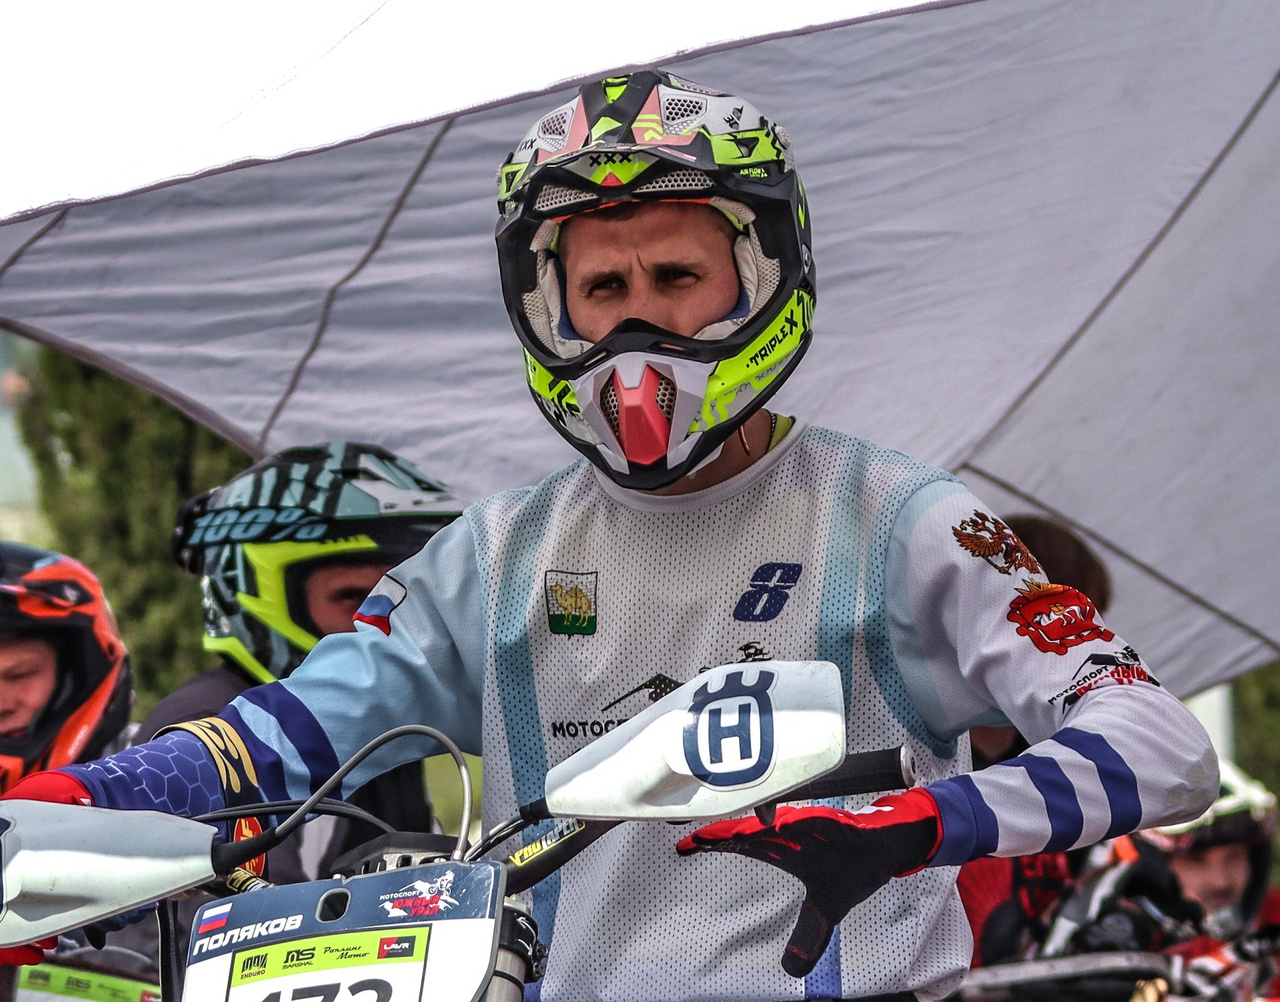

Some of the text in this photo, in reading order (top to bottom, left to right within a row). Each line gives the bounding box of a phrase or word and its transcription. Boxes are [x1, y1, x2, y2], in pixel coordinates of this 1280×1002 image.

[187, 507, 329, 547] 100%
[732, 561, 803, 623] 8
[1047, 665, 1109, 706] МОТОСПОРТ
[551, 717, 630, 739] МОТОС
[379, 890, 420, 901] МОТОСПОРТ
[192, 914, 304, 957] ПОЛЯКОВ
[383, 942, 410, 951] LAVR
[240, 969, 266, 980] ENDURO
[282, 961, 314, 970] MARSHAL
